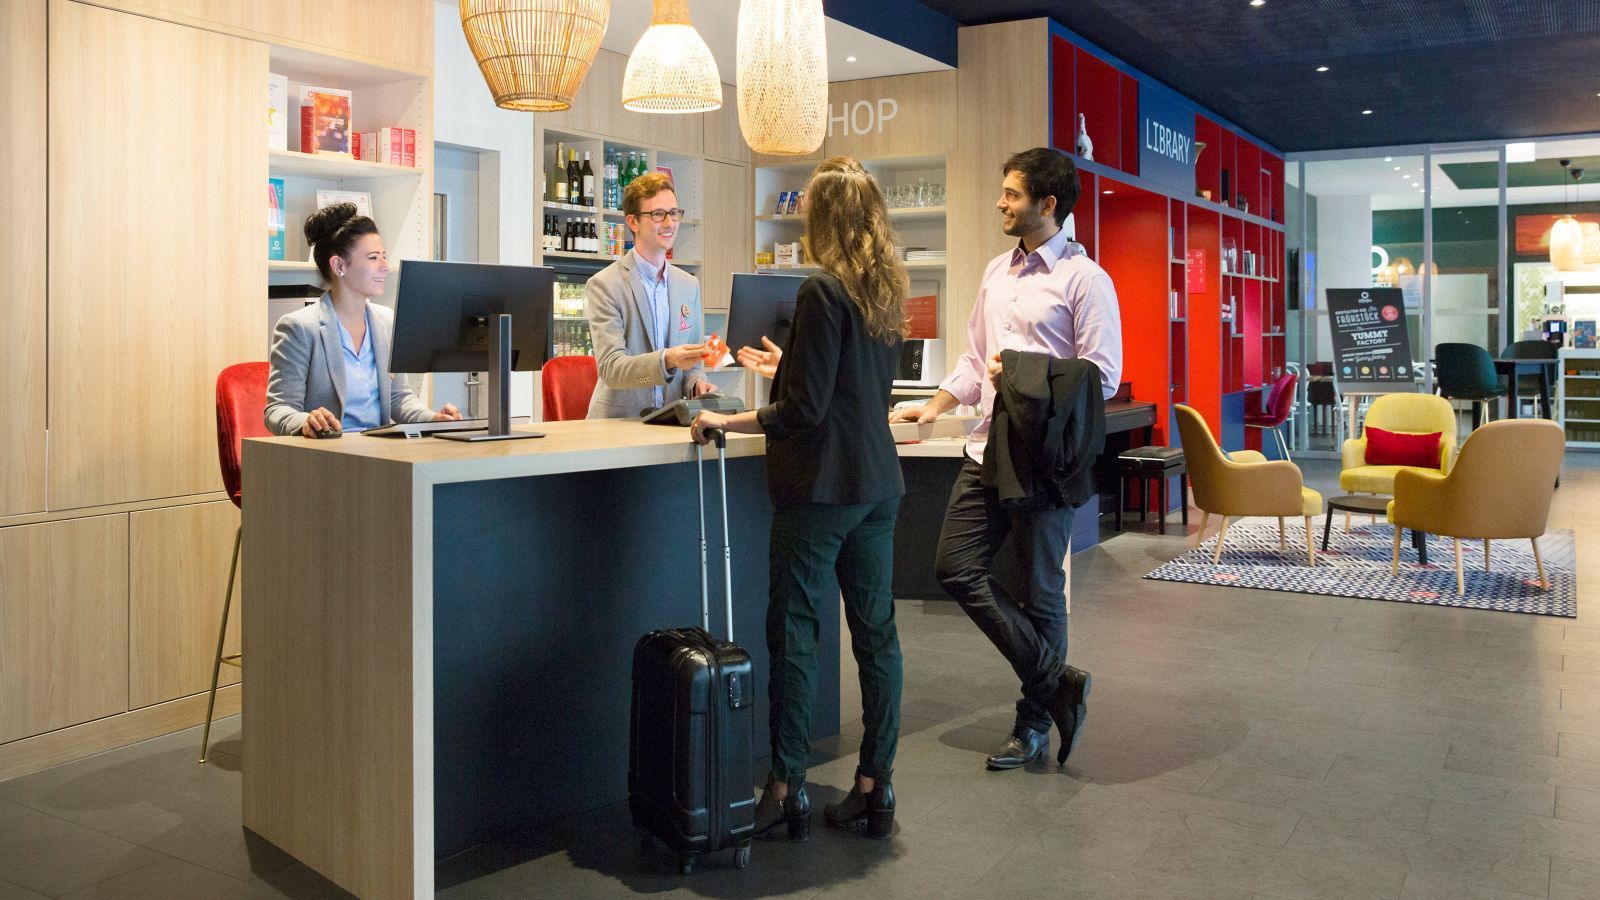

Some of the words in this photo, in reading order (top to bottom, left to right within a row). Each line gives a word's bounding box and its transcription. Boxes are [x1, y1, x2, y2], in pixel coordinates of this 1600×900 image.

[828, 98, 898, 138] HOP
[1146, 117, 1190, 165] LIBRARY
[1351, 330, 1388, 341] YUMMY
[1357, 338, 1387, 346] FACTORY
